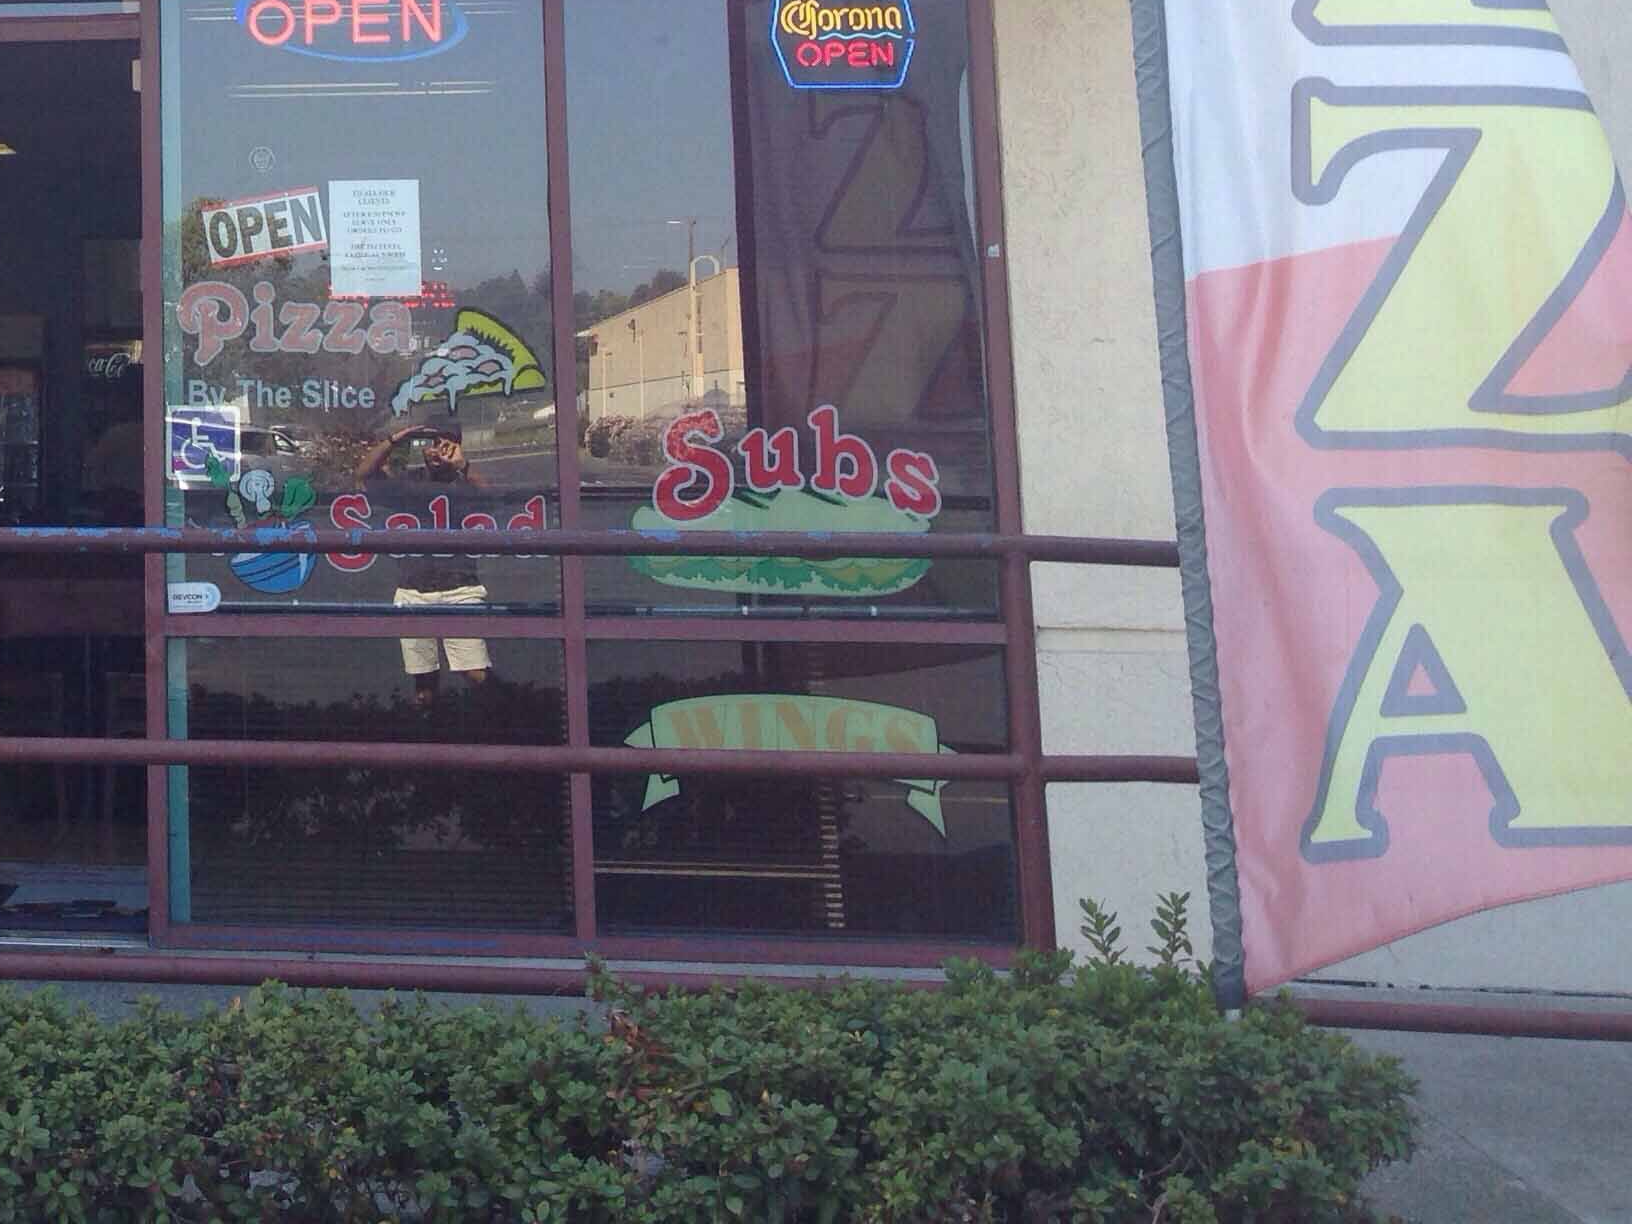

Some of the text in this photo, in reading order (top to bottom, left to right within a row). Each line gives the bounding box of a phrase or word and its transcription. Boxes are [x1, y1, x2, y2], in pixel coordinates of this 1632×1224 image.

[779, 0, 903, 41] Corona
[796, 41, 895, 68] OPEN
[208, 194, 324, 259] OPEN
[176, 281, 413, 367] Pizza
[187, 377, 377, 412] By The Slice
[651, 404, 942, 521] Subs
[325, 494, 551, 573] Salad
[665, 700, 928, 752] WINGS
